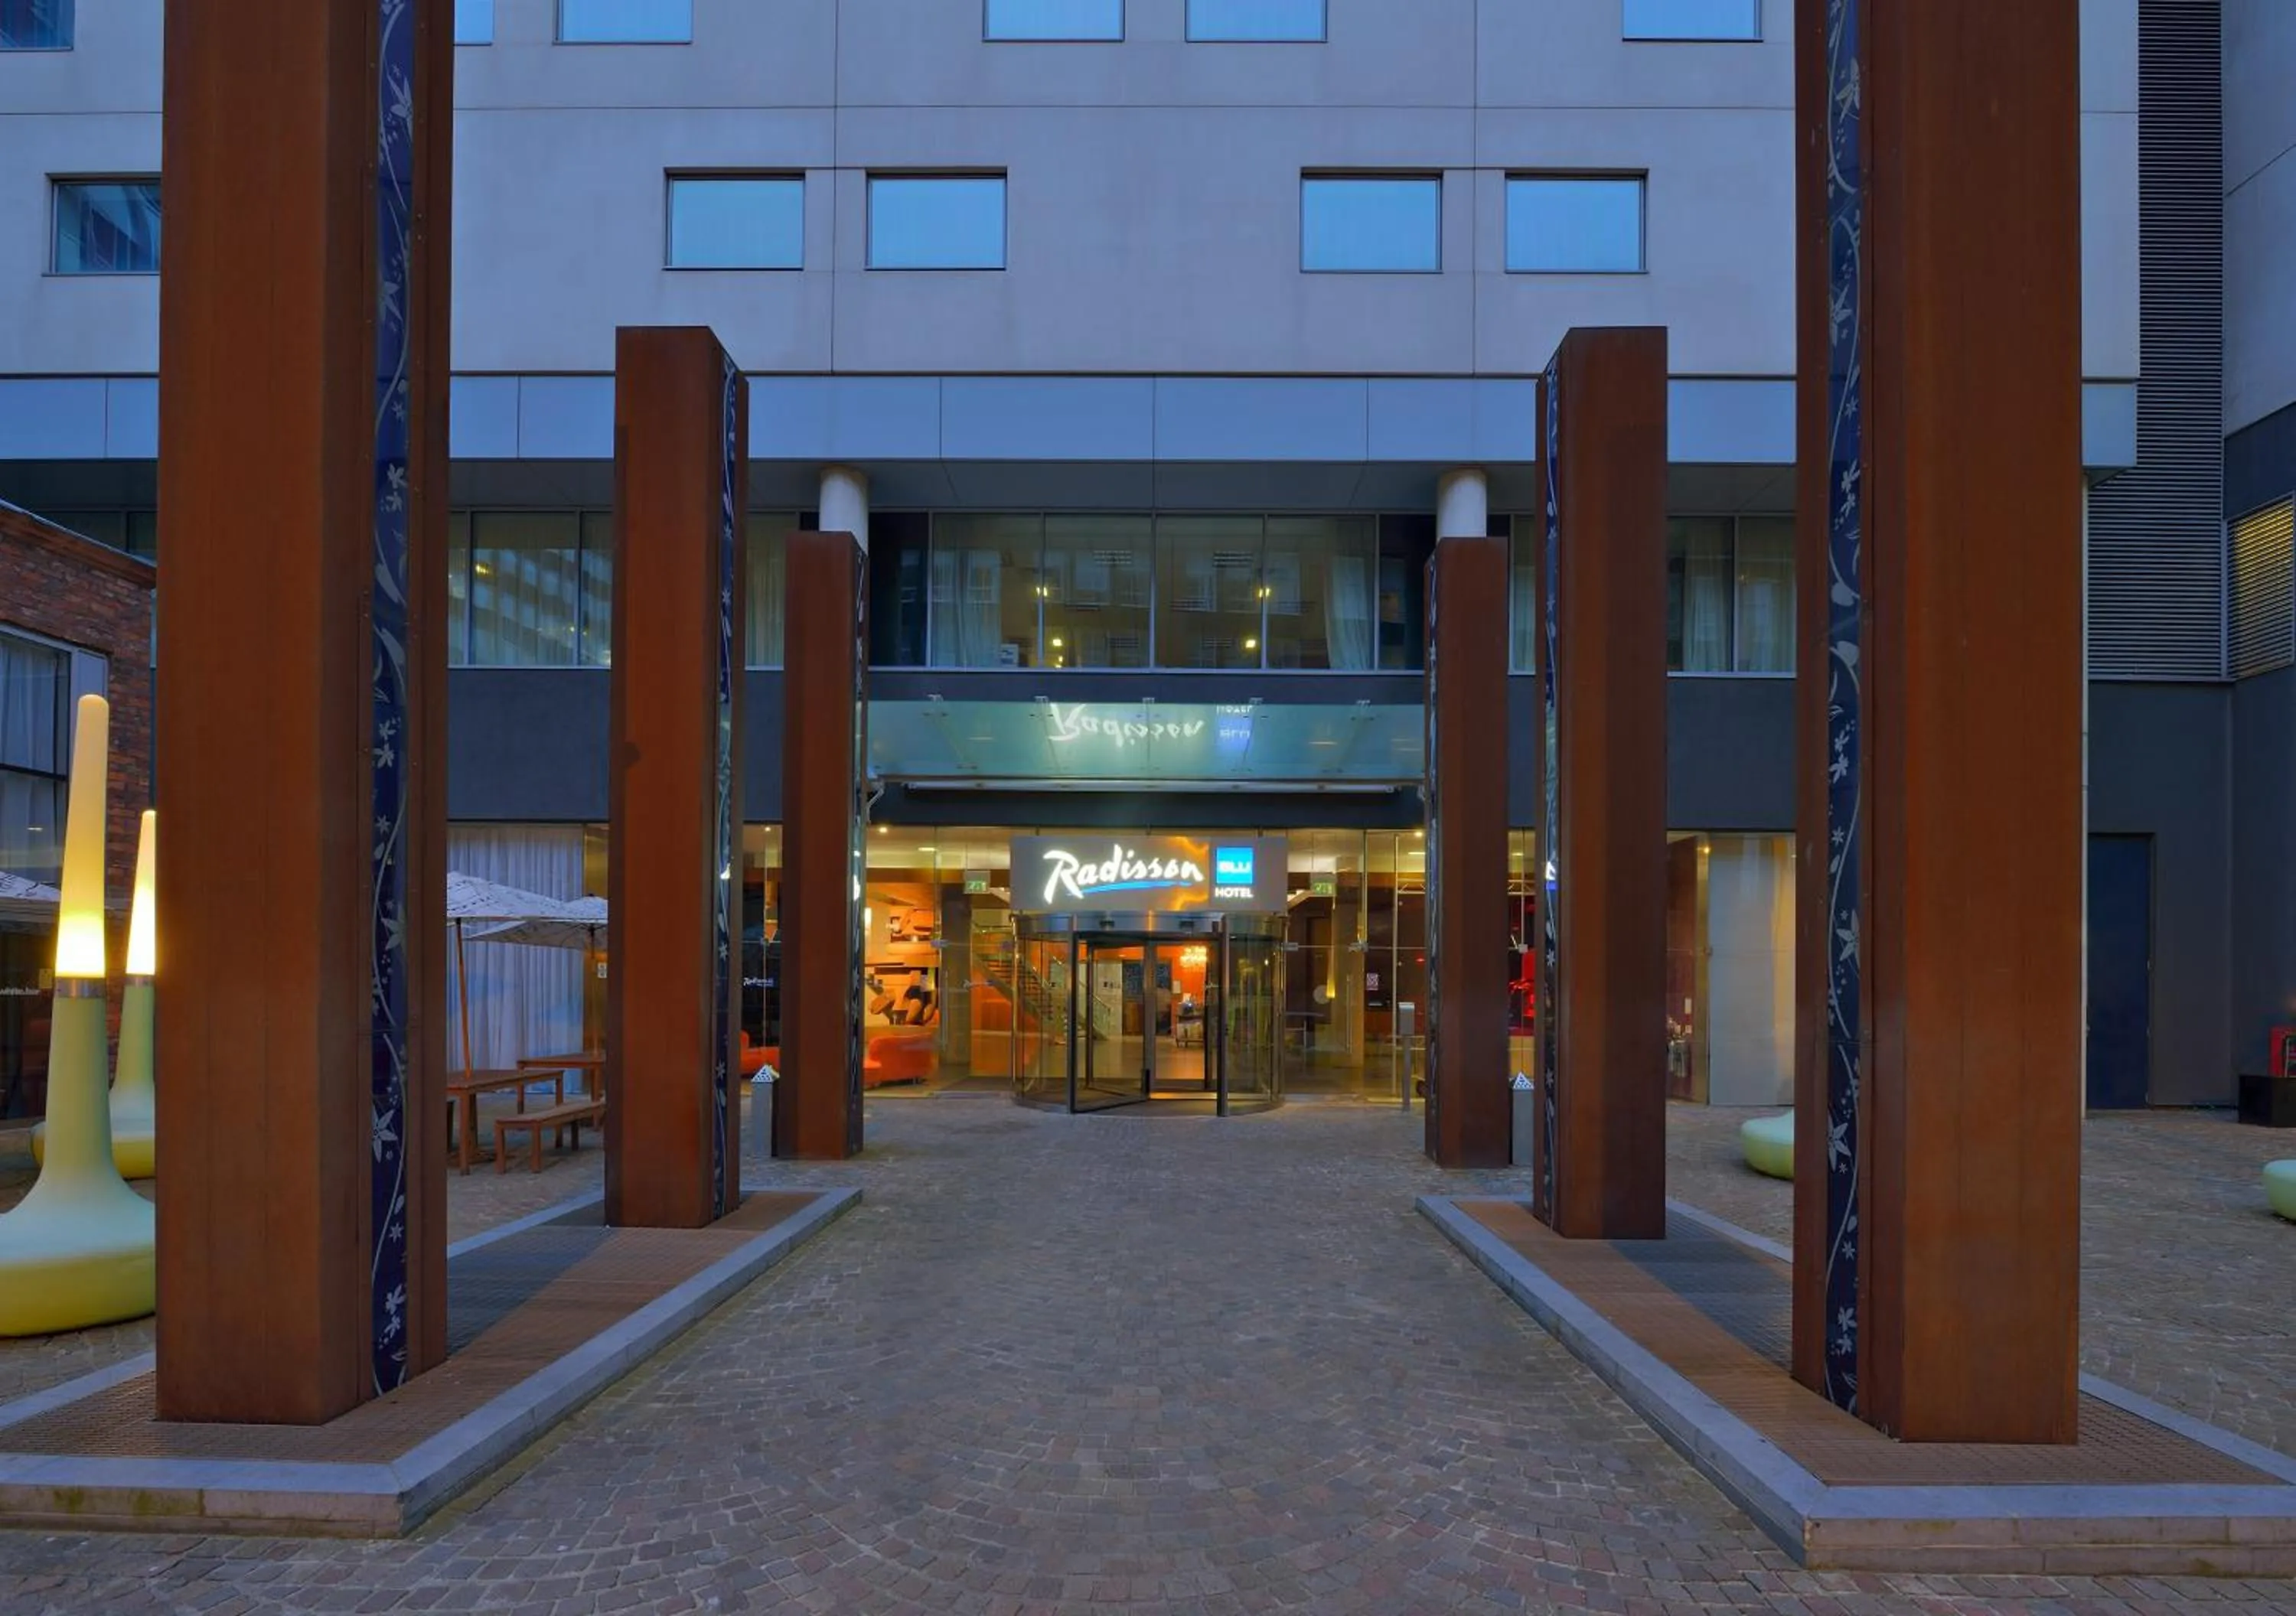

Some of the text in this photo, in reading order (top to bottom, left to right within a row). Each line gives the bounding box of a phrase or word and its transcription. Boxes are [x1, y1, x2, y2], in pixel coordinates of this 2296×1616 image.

[1043, 844, 1251, 904] Radisson BLU
[1215, 888, 1254, 898] HOTEL
